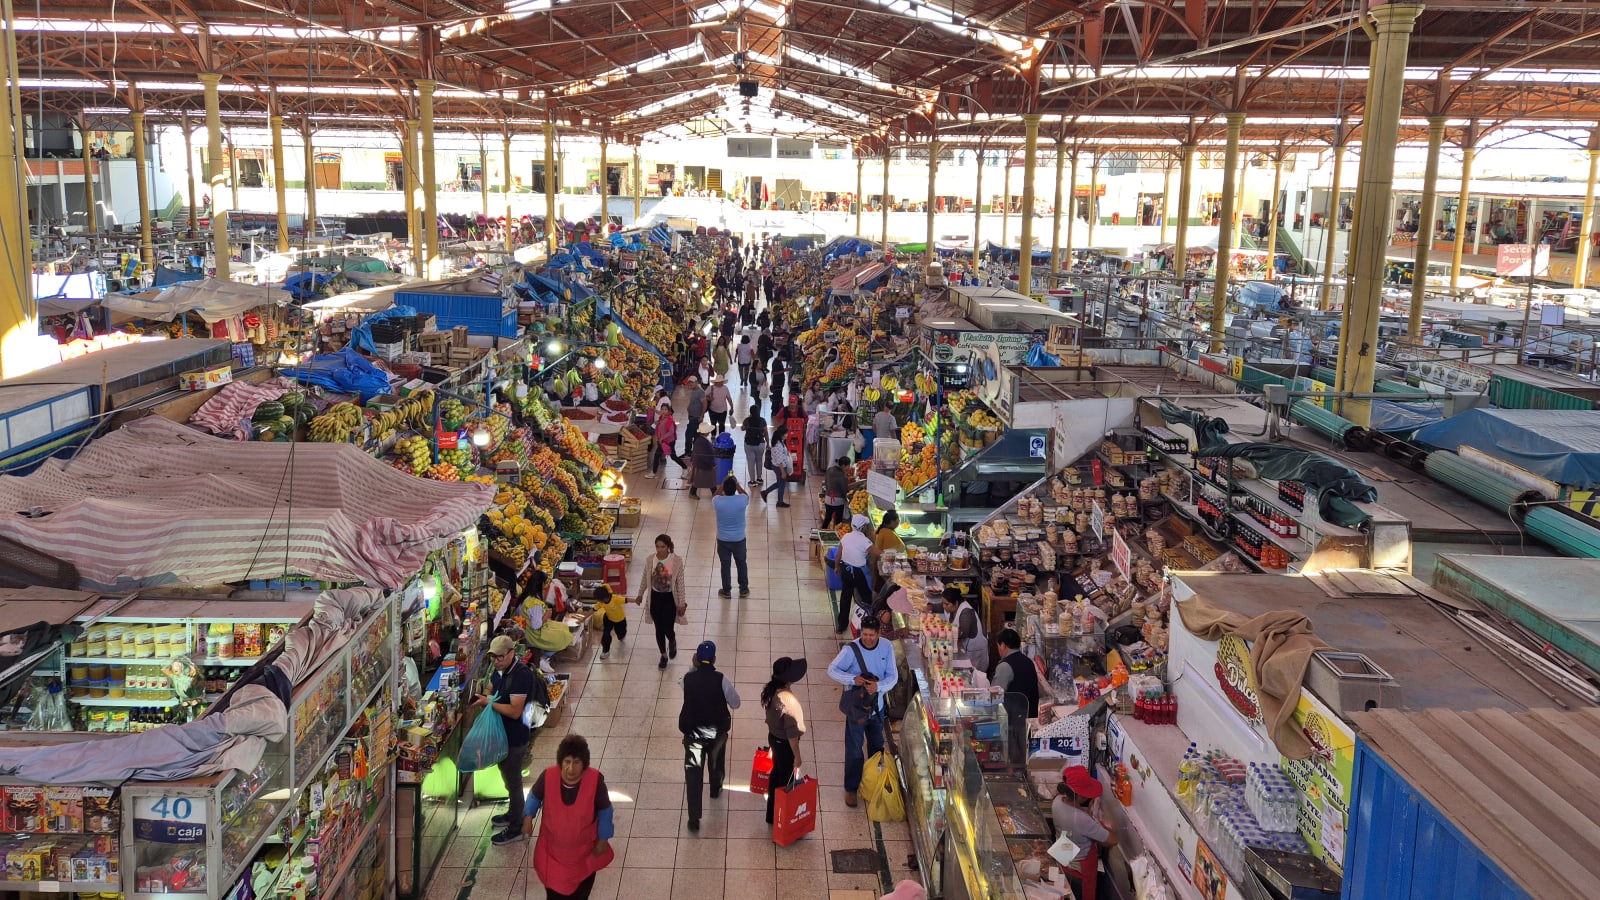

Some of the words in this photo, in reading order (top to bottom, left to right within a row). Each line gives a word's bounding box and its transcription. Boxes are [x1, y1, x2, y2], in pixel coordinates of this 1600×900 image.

[1235, 360, 1240, 374] 5
[1057, 739, 1073, 748] 202
[1287, 767, 1307, 792] POLLO
[151, 797, 192, 819] 40
[178, 827, 203, 837] caja
[1296, 815, 1317, 841] ZANA
